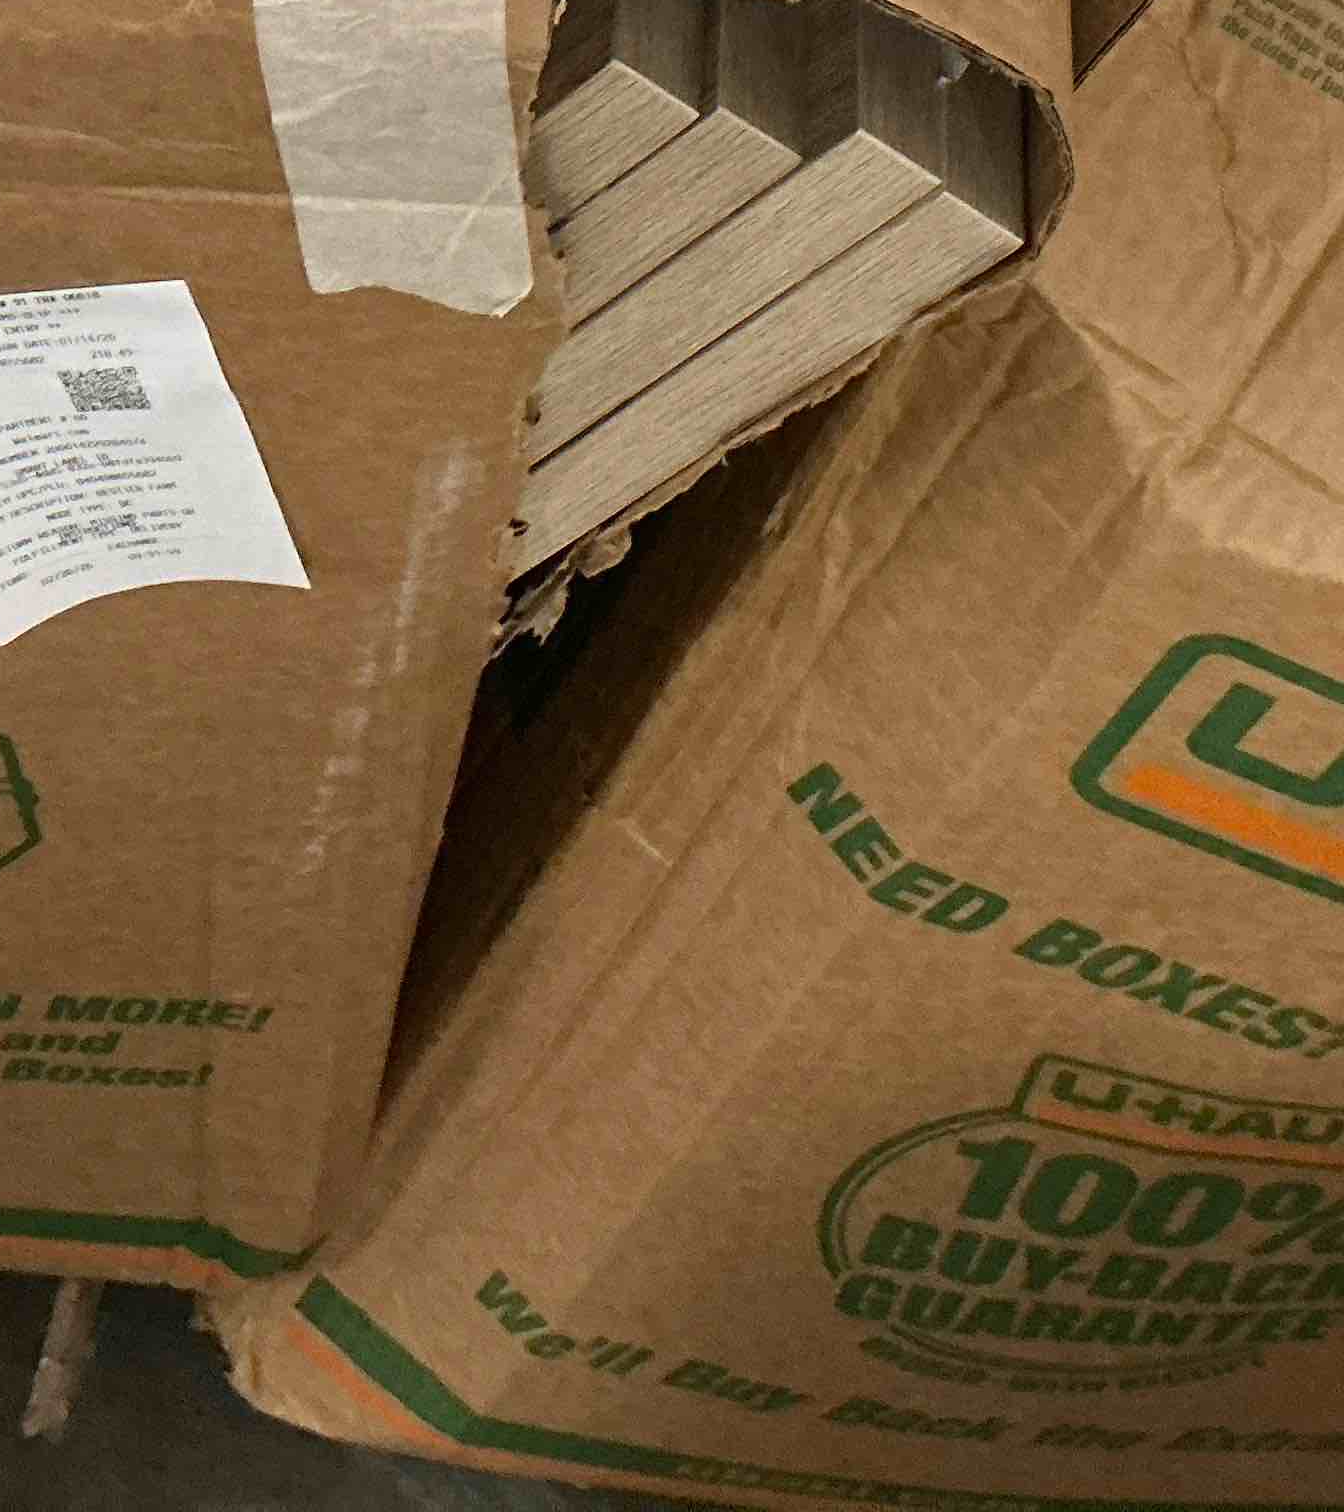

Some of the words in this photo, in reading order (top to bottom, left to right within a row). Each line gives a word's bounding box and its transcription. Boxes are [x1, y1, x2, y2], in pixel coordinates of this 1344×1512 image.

[785, 760, 1011, 937] NEED
[44, 993, 278, 1034] MORE!
[0, 1058, 218, 1090] Boxes!
[474, 1269, 654, 1378] We'll
[659, 1356, 814, 1418] Buy
